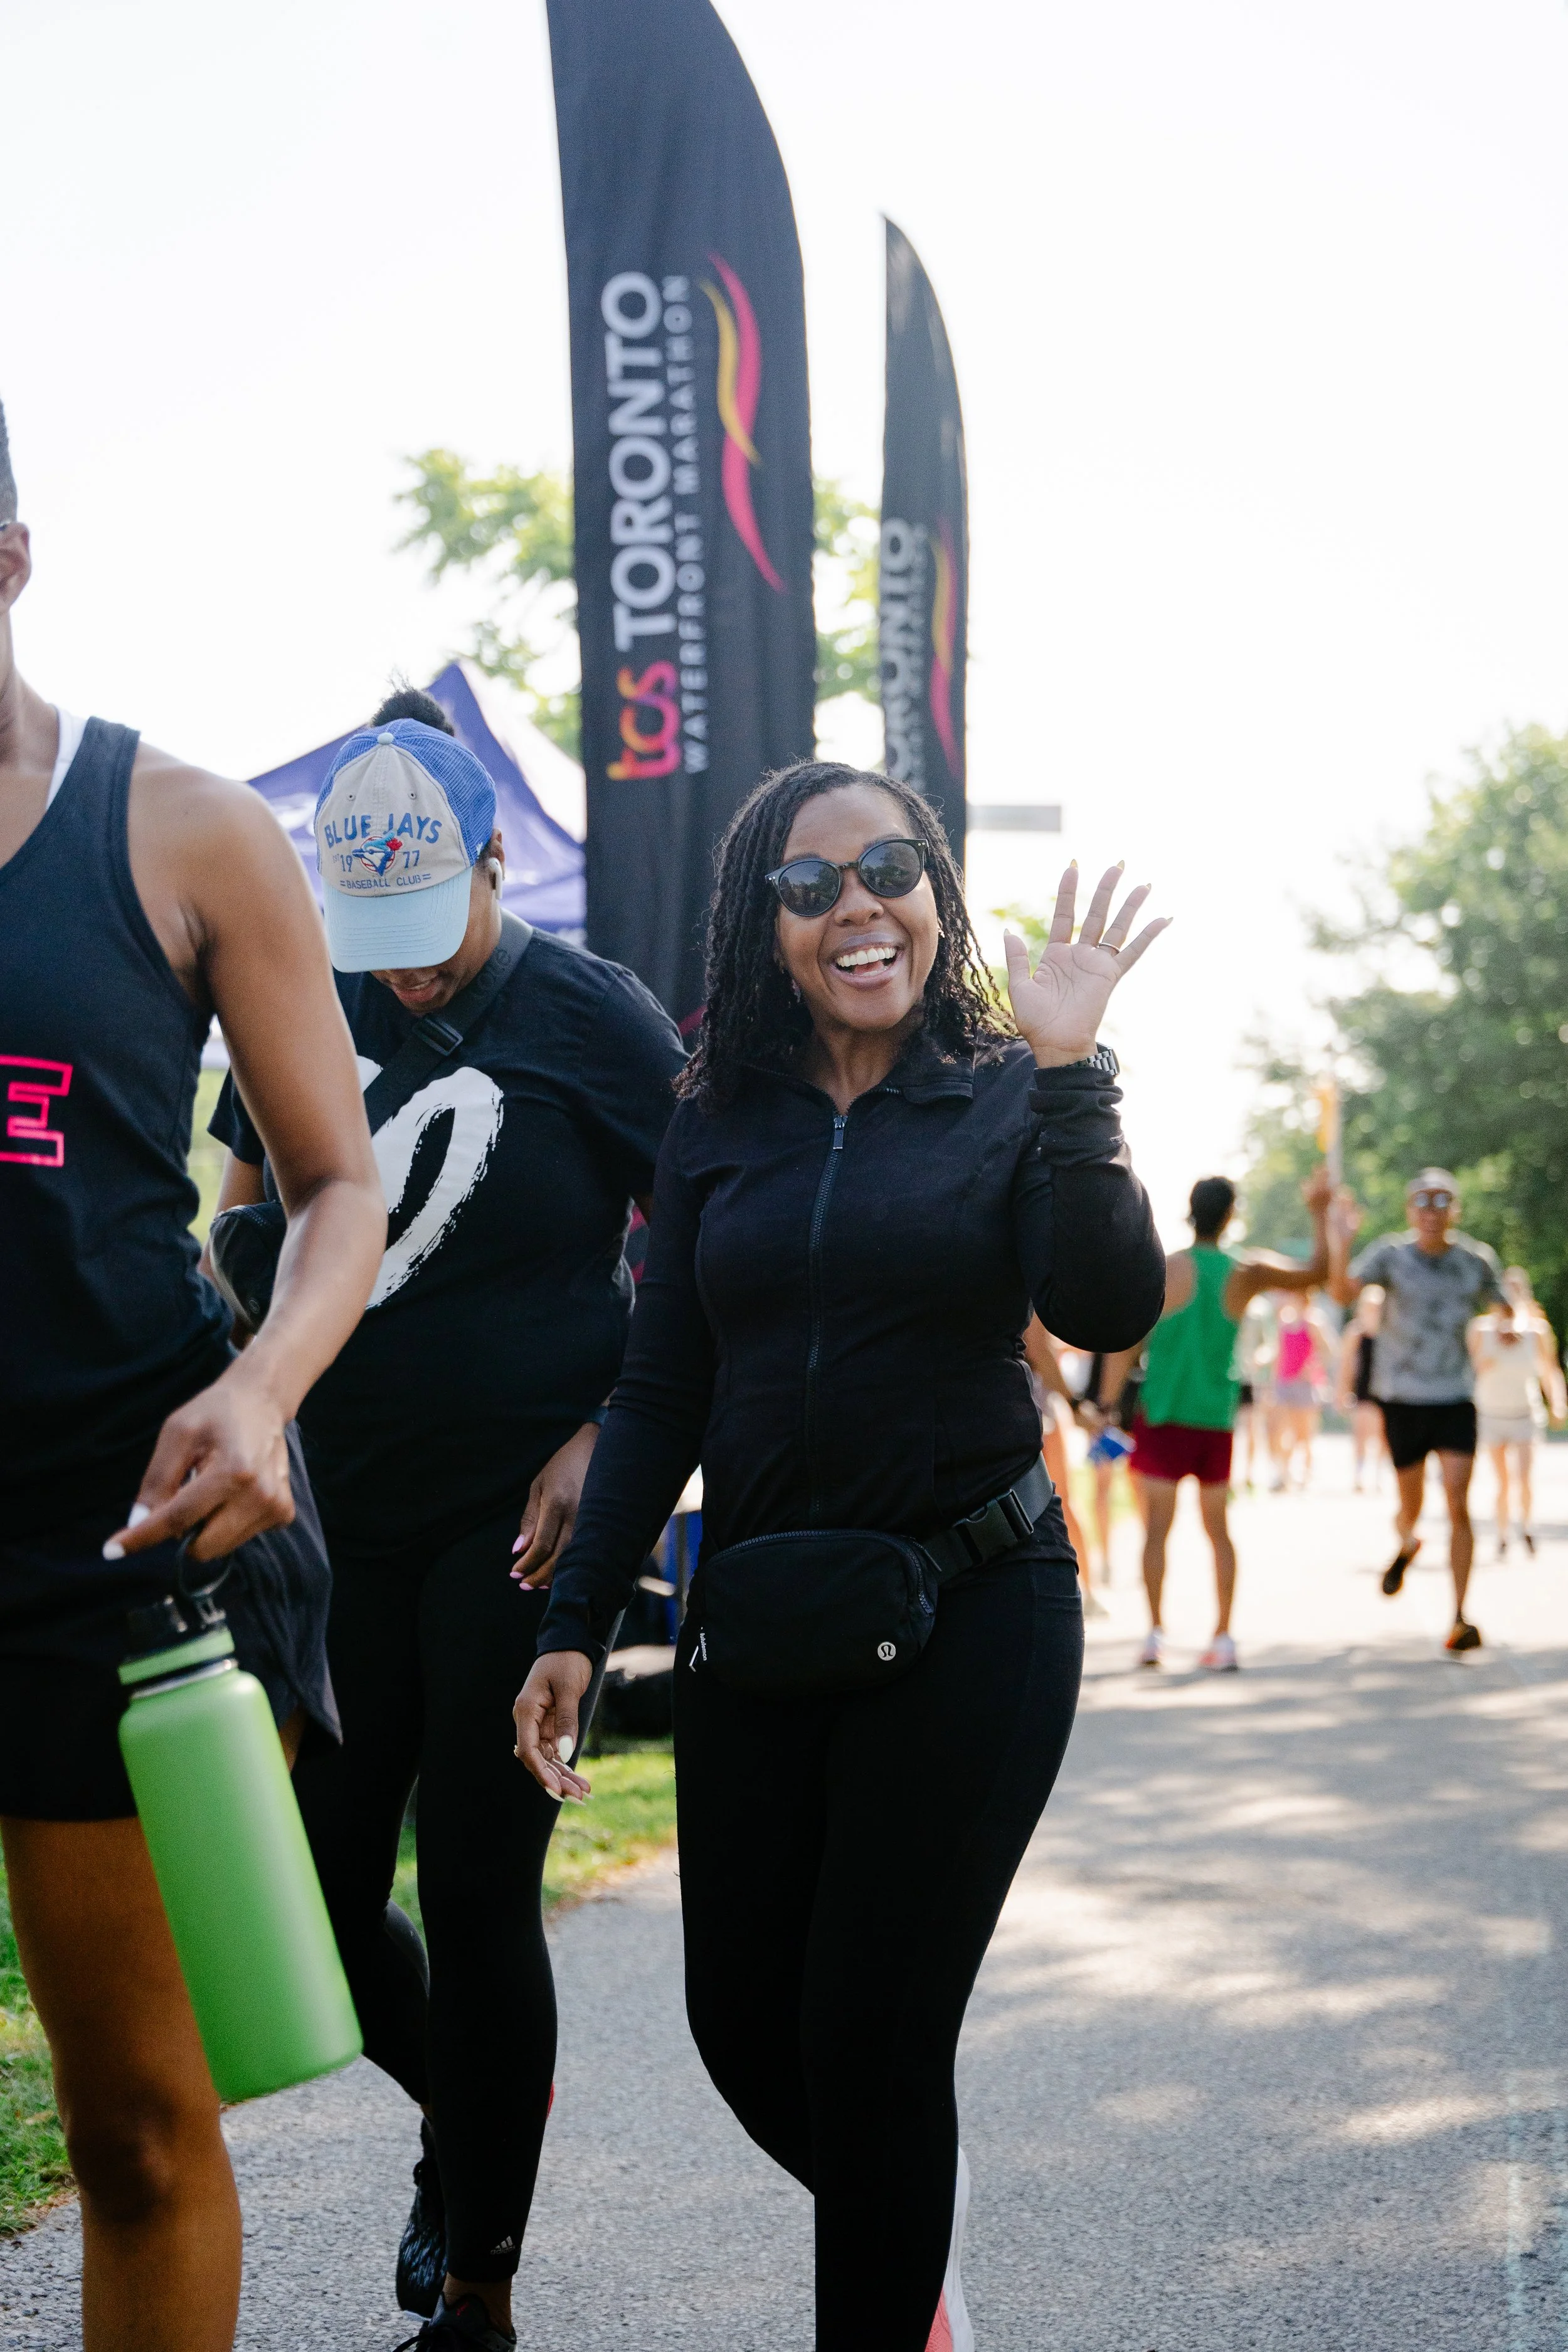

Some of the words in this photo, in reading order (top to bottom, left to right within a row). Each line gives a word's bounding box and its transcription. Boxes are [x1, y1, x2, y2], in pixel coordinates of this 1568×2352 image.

[661, 274, 699, 494] MARATHON
[601, 270, 678, 652] TORONTO
[675, 514, 708, 774] WATERFRONT
[324, 815, 371, 849] BLUE
[383, 813, 442, 844] JAYS
[340, 854, 352, 872] 19
[403, 849, 420, 869] 77
[346, 879, 390, 889] BASEBALL
[396, 876, 421, 886] CLUB
[699, 1633, 707, 1661] lululemon
